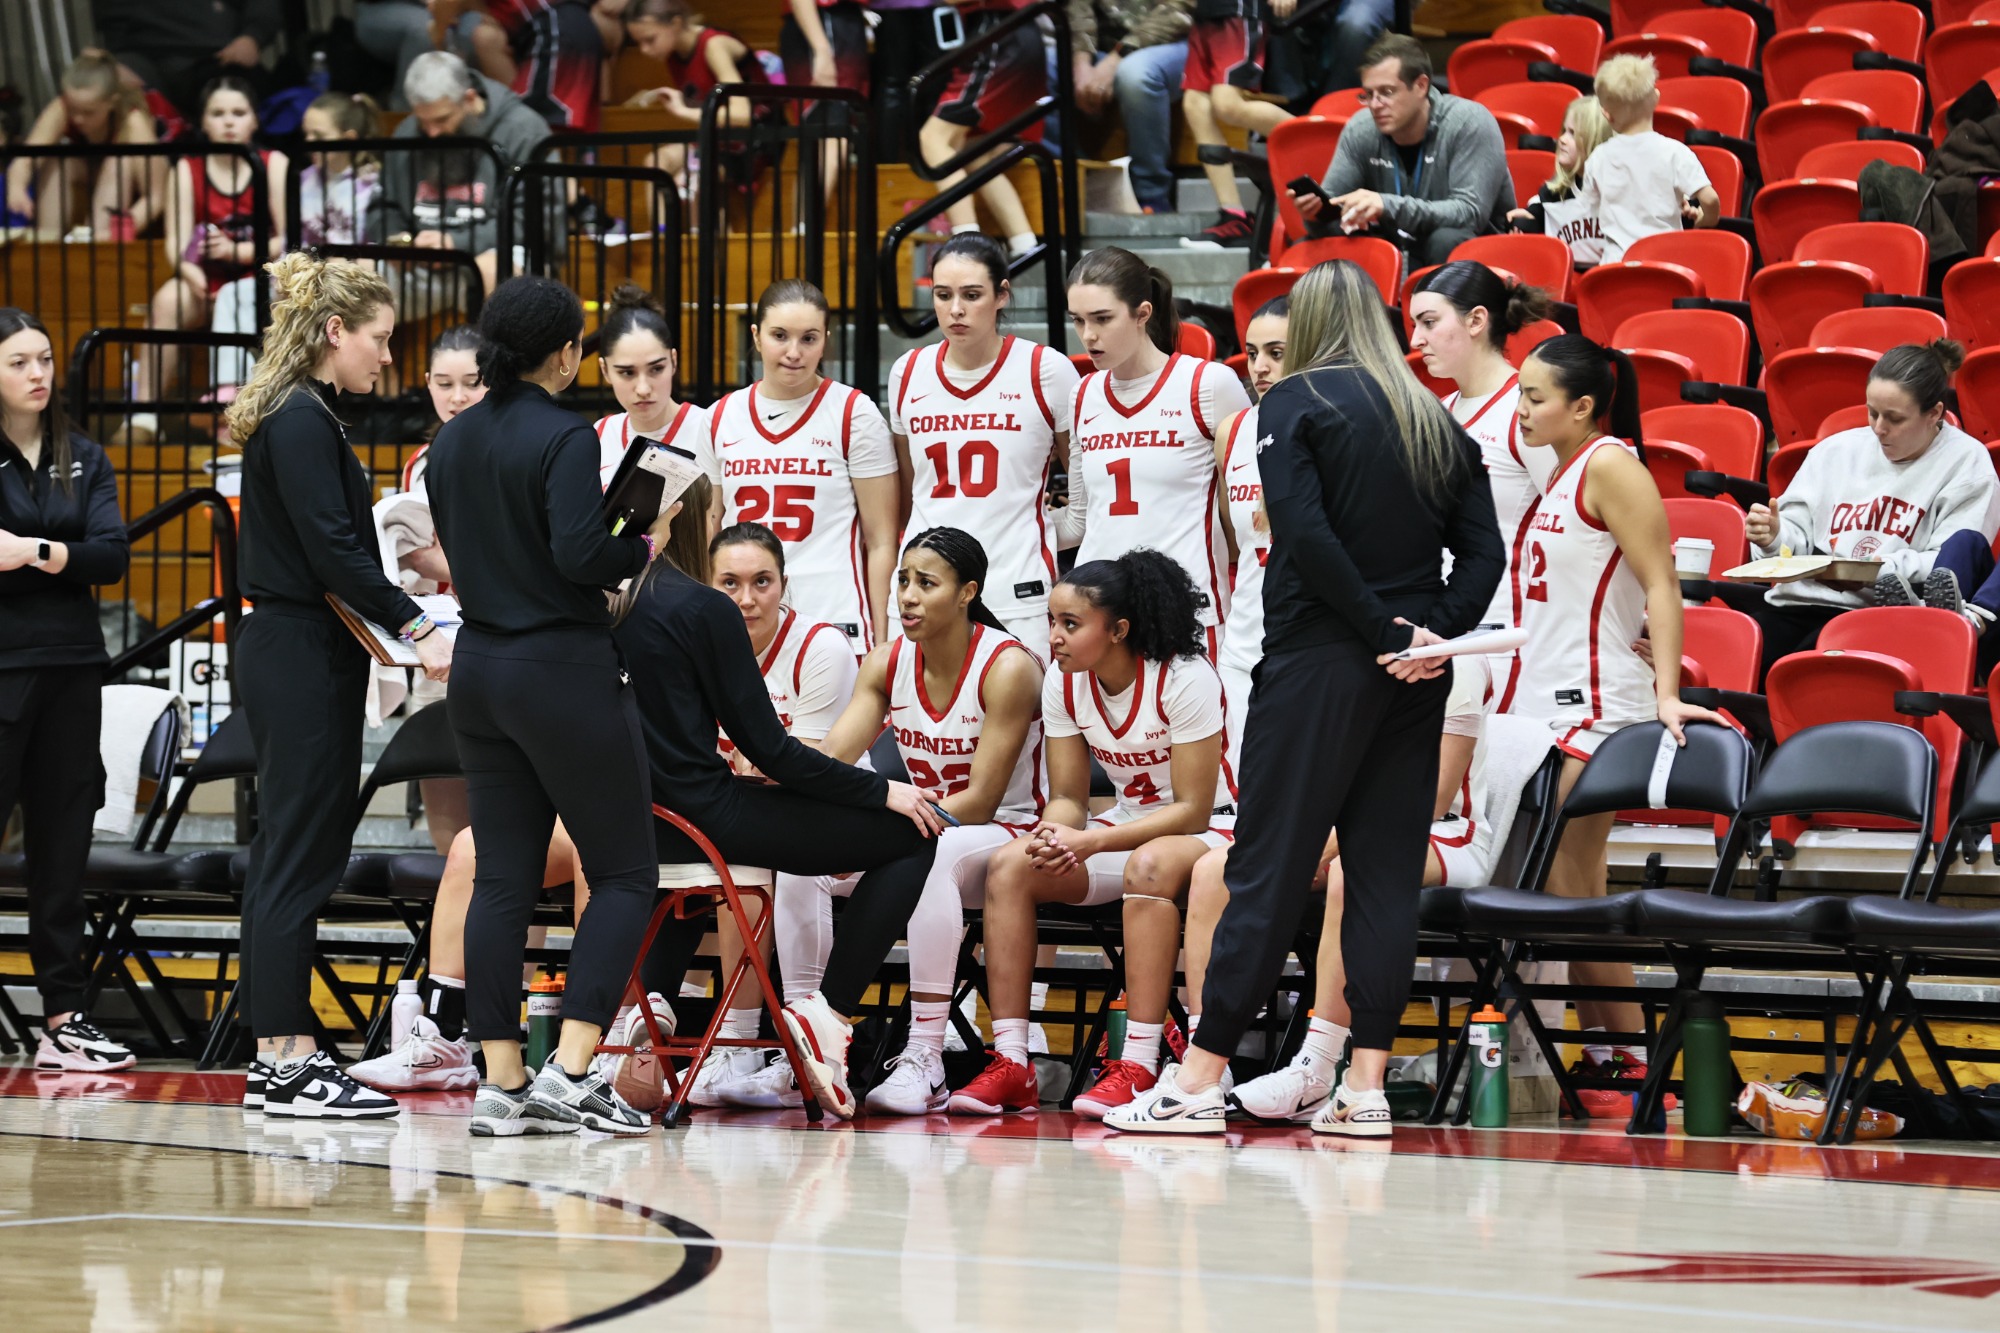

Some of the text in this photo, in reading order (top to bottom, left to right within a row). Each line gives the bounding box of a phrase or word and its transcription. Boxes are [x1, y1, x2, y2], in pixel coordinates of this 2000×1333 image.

[999, 392, 1014, 401] Ivy
[909, 413, 1022, 434] CORNELL
[1160, 408, 1175, 418] Ivy
[811, 437, 826, 447] Ivy
[1081, 430, 1185, 453] CORNELL
[724, 458, 833, 477] CORNELL
[924, 440, 999, 499] 10
[1105, 457, 1139, 516] 1
[734, 485, 816, 542] 25
[1526, 540, 1548, 602] 2
[1145, 731, 1160, 740] Ivy
[1123, 771, 1166, 805] 4
